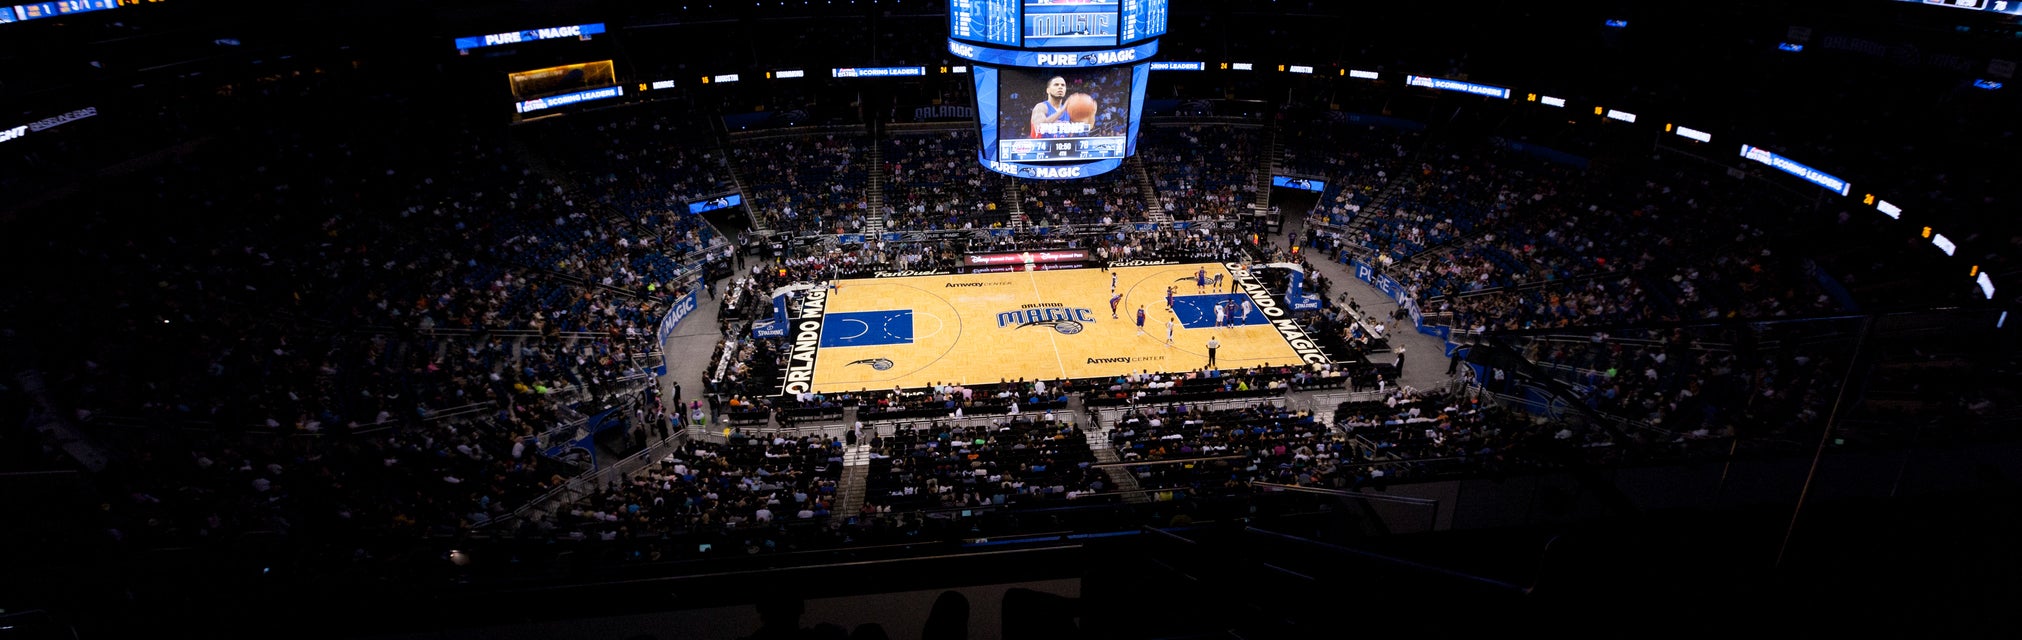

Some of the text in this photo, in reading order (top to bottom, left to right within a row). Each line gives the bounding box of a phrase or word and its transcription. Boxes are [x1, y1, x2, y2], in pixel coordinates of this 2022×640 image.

[485, 26, 580, 45] PURE MAGIC
[1037, 49, 1135, 66] PURE MAGIC
[547, 94, 581, 106] SCORING
[581, 89, 615, 100] LEADERS
[1435, 81, 1467, 91] SCORING
[1468, 84, 1502, 96] LEADERS
[990, 160, 1080, 178] PURE MAGIC
[1773, 157, 1807, 176] SCORING
[1805, 170, 1843, 190] LEADERS
[970, 255, 990, 264] Disney
[1040, 252, 1059, 260] Disney
[665, 296, 694, 333] MAGIC
[996, 307, 1096, 329] MAGIC
[1226, 262, 1326, 364] ORLANDO MAGIC
[785, 320, 820, 395] ORLANDO
[1087, 356, 1131, 365] Amway
